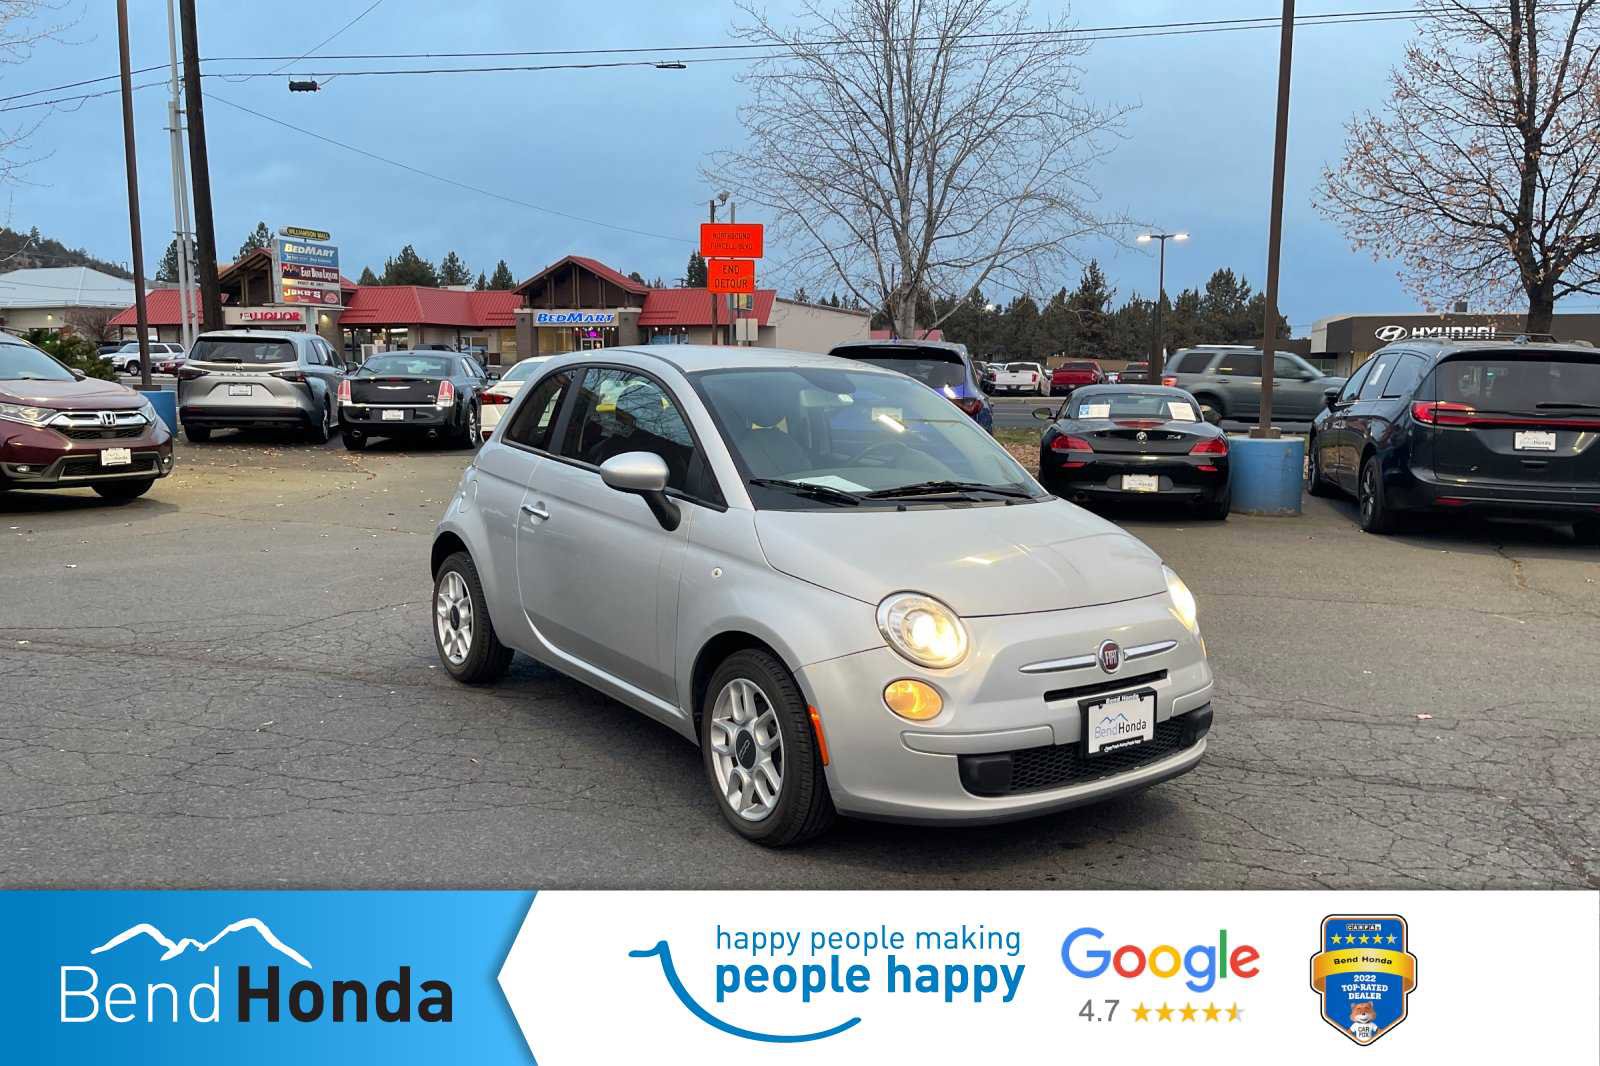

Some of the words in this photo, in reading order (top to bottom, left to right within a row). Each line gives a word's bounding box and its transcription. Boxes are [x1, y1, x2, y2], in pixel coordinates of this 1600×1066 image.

[722, 265, 740, 274] END
[714, 278, 748, 289] DETOUR
[252, 311, 301, 321] LIQUOR
[1411, 326, 1496, 340] HYUNDAI
